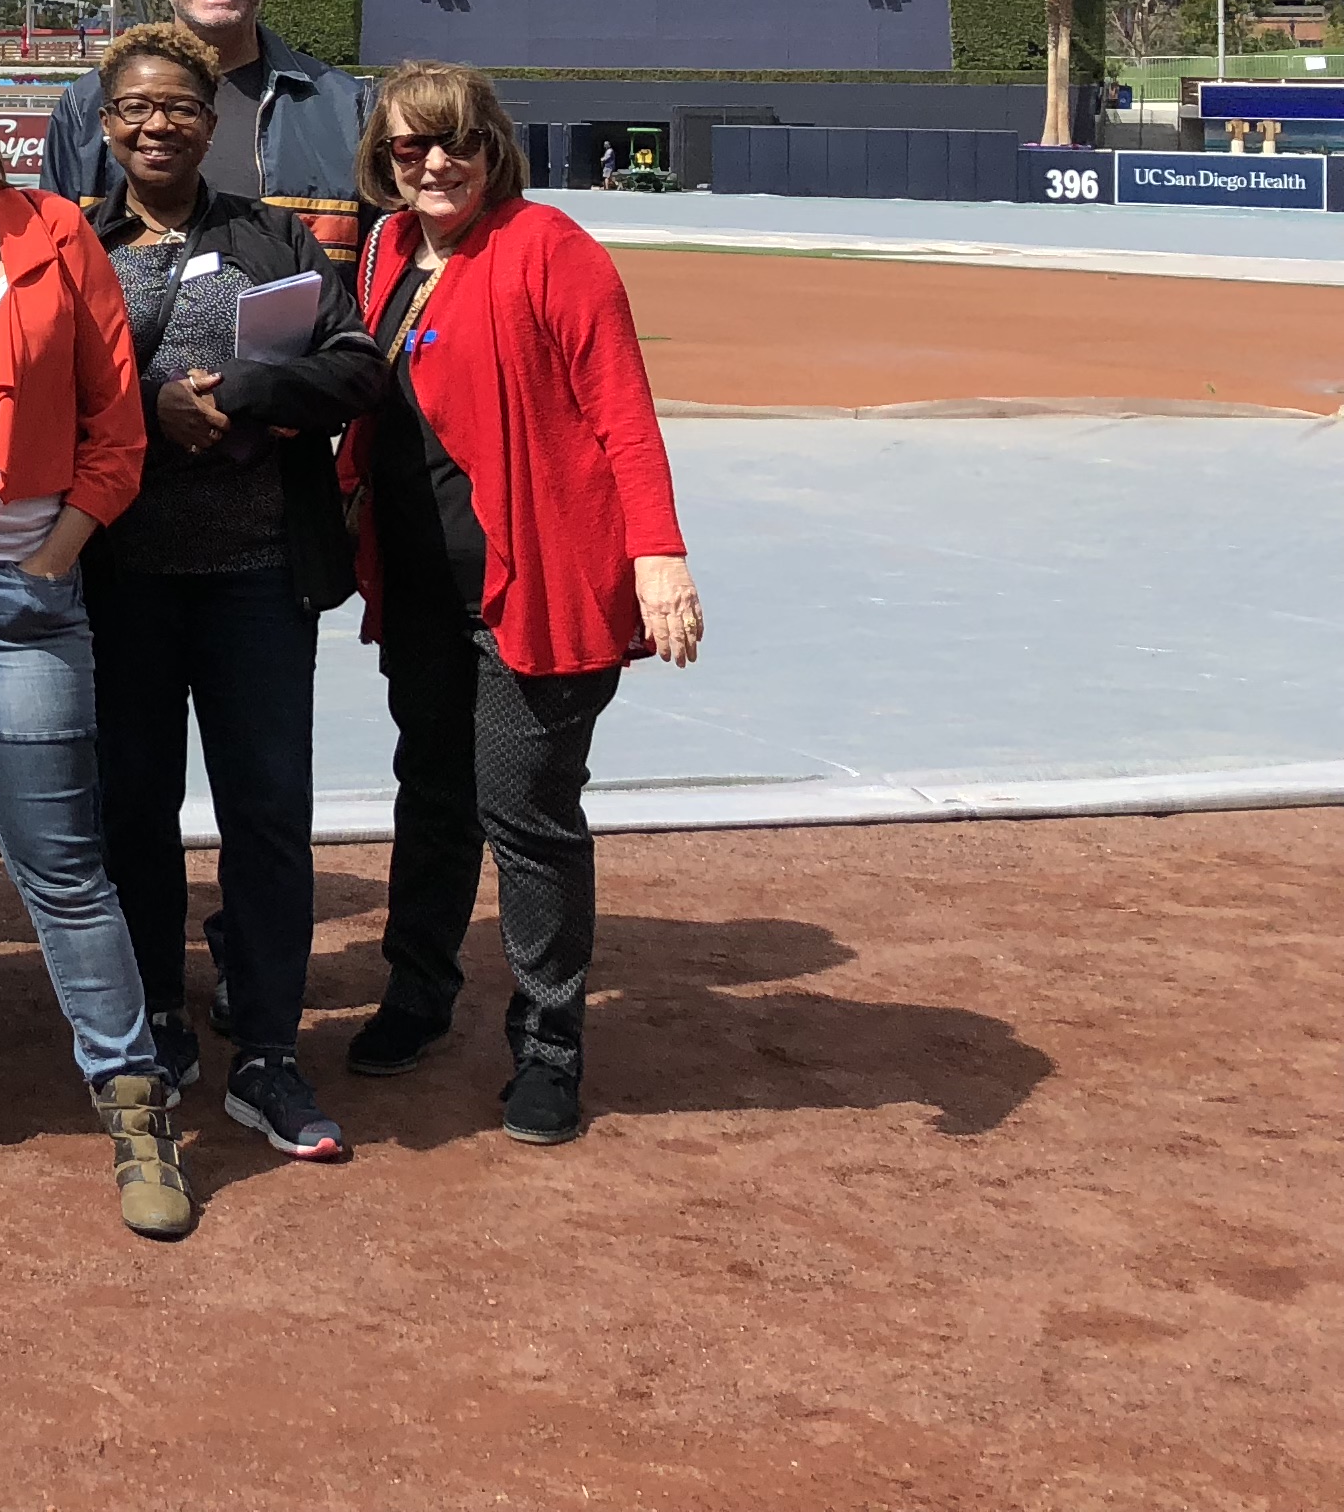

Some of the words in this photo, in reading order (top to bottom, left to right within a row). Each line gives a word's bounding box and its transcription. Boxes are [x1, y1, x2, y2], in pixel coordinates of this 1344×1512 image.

[1045, 168, 1099, 200] 396
[1133, 168, 1162, 186] UC
[1164, 169, 1196, 187] San
[1198, 170, 1248, 191] Diego
[1249, 171, 1307, 190] Health
